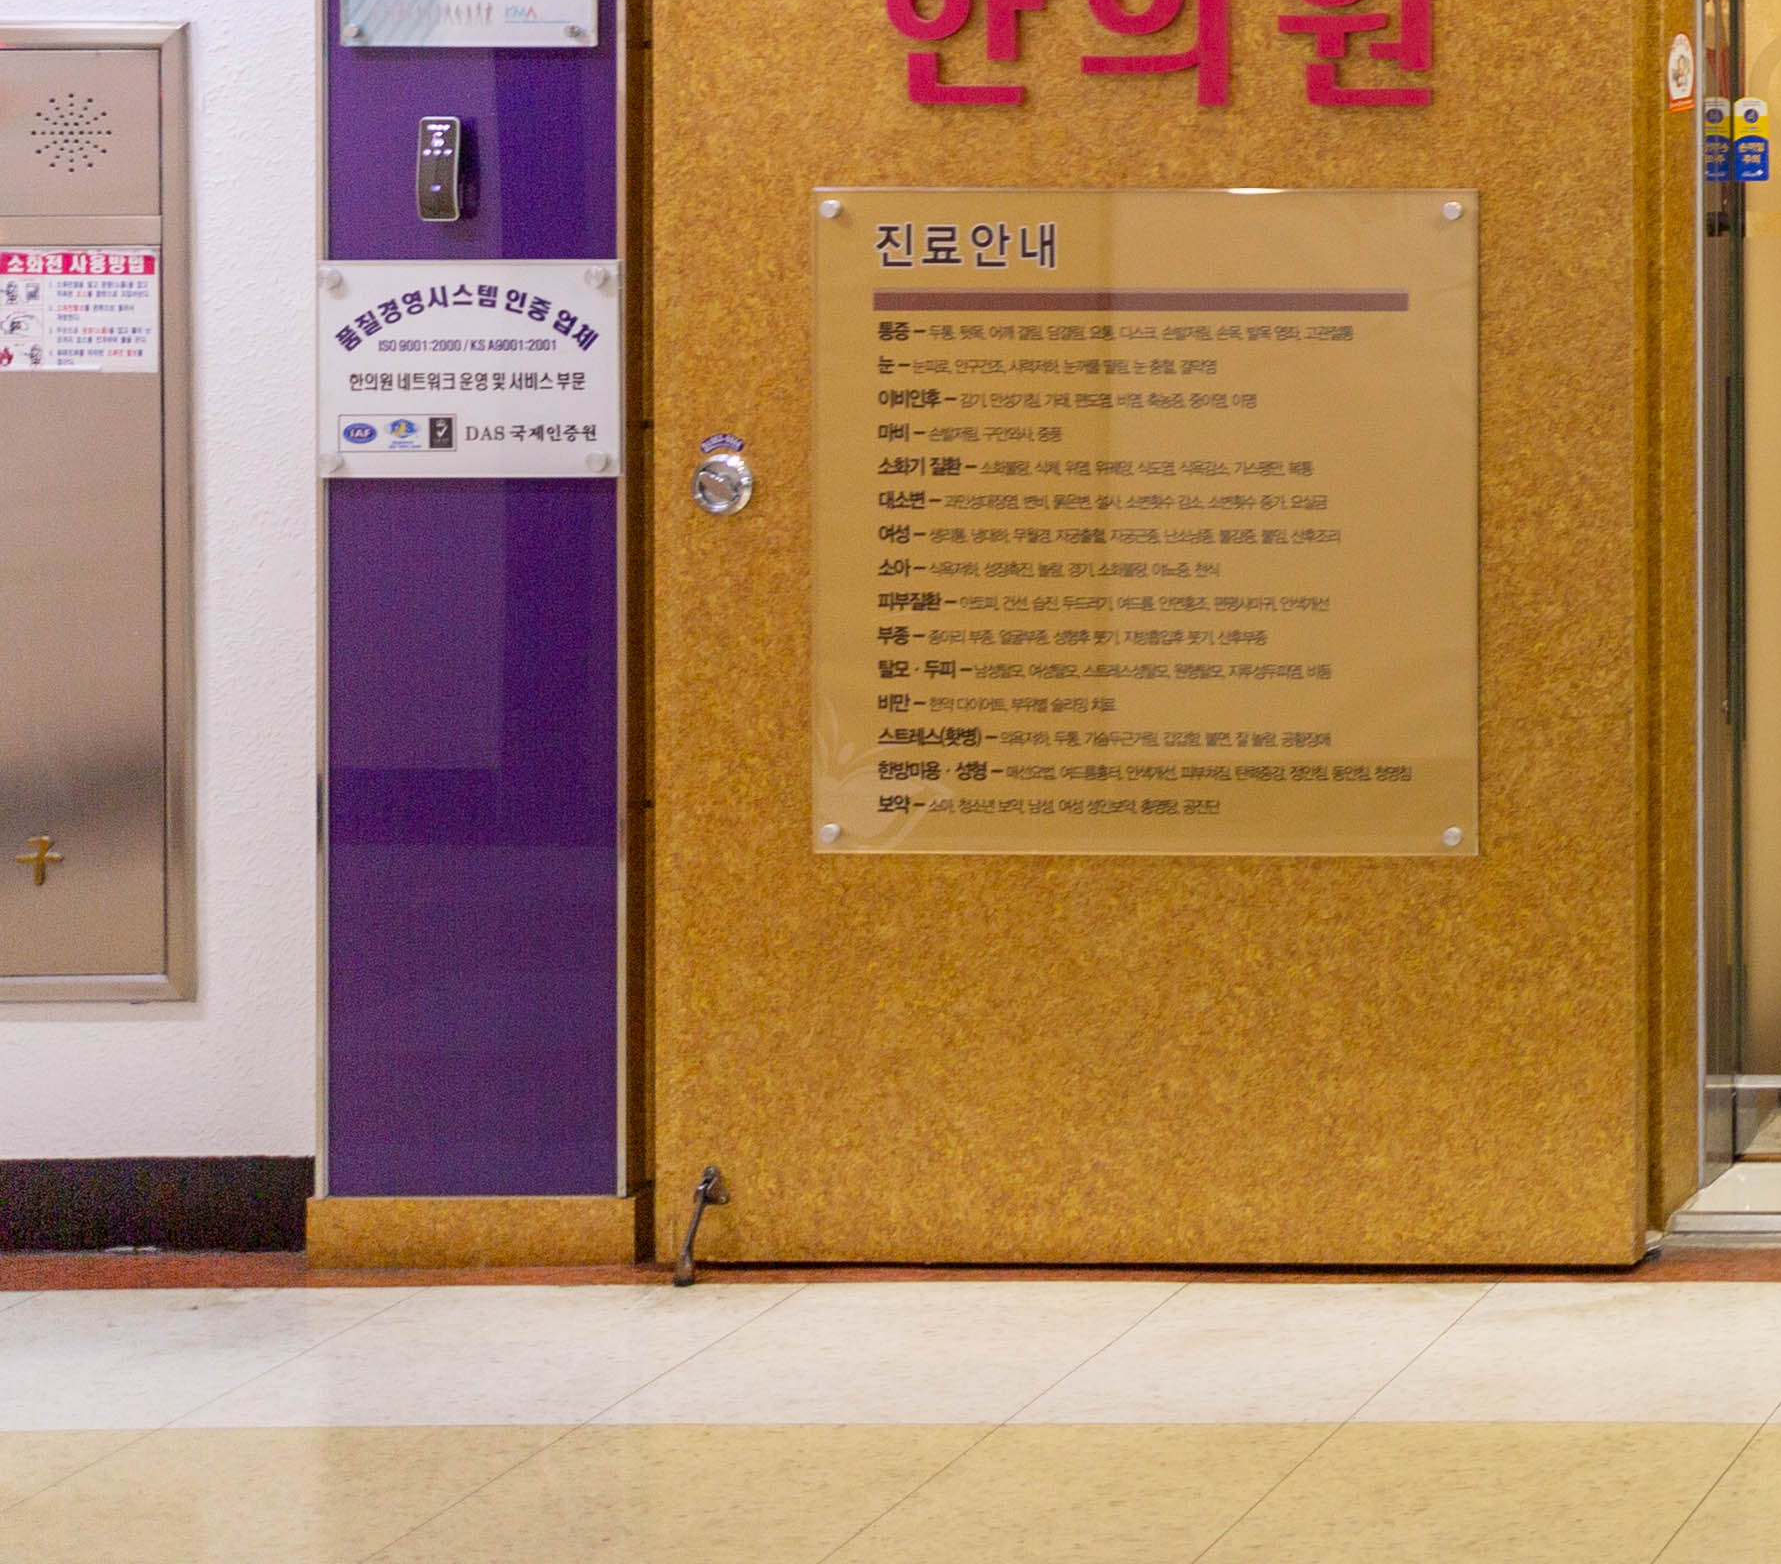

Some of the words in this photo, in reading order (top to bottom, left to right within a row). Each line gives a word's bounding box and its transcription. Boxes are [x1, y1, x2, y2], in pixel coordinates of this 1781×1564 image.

[875, 222, 1057, 269] 진료안내
[7, 255, 63, 274] 소화전
[69, 255, 145, 274] 사용방법
[335, 284, 497, 352] 품질경영시스템
[505, 289, 552, 322] 인증
[552, 309, 600, 352] 업체
[378, 340, 397, 351] ISO
[399, 339, 461, 351] 9001:2000
[470, 340, 486, 351] KS
[349, 373, 393, 392] 한의원
[398, 373, 456, 391] 네트워크
[460, 373, 488, 391] 운영
[492, 373, 505, 391] 및
[509, 373, 552, 391] 서비스
[557, 373, 585, 391] 부문
[465, 425, 504, 441] DAS
[509, 425, 597, 443] 국제인증원
